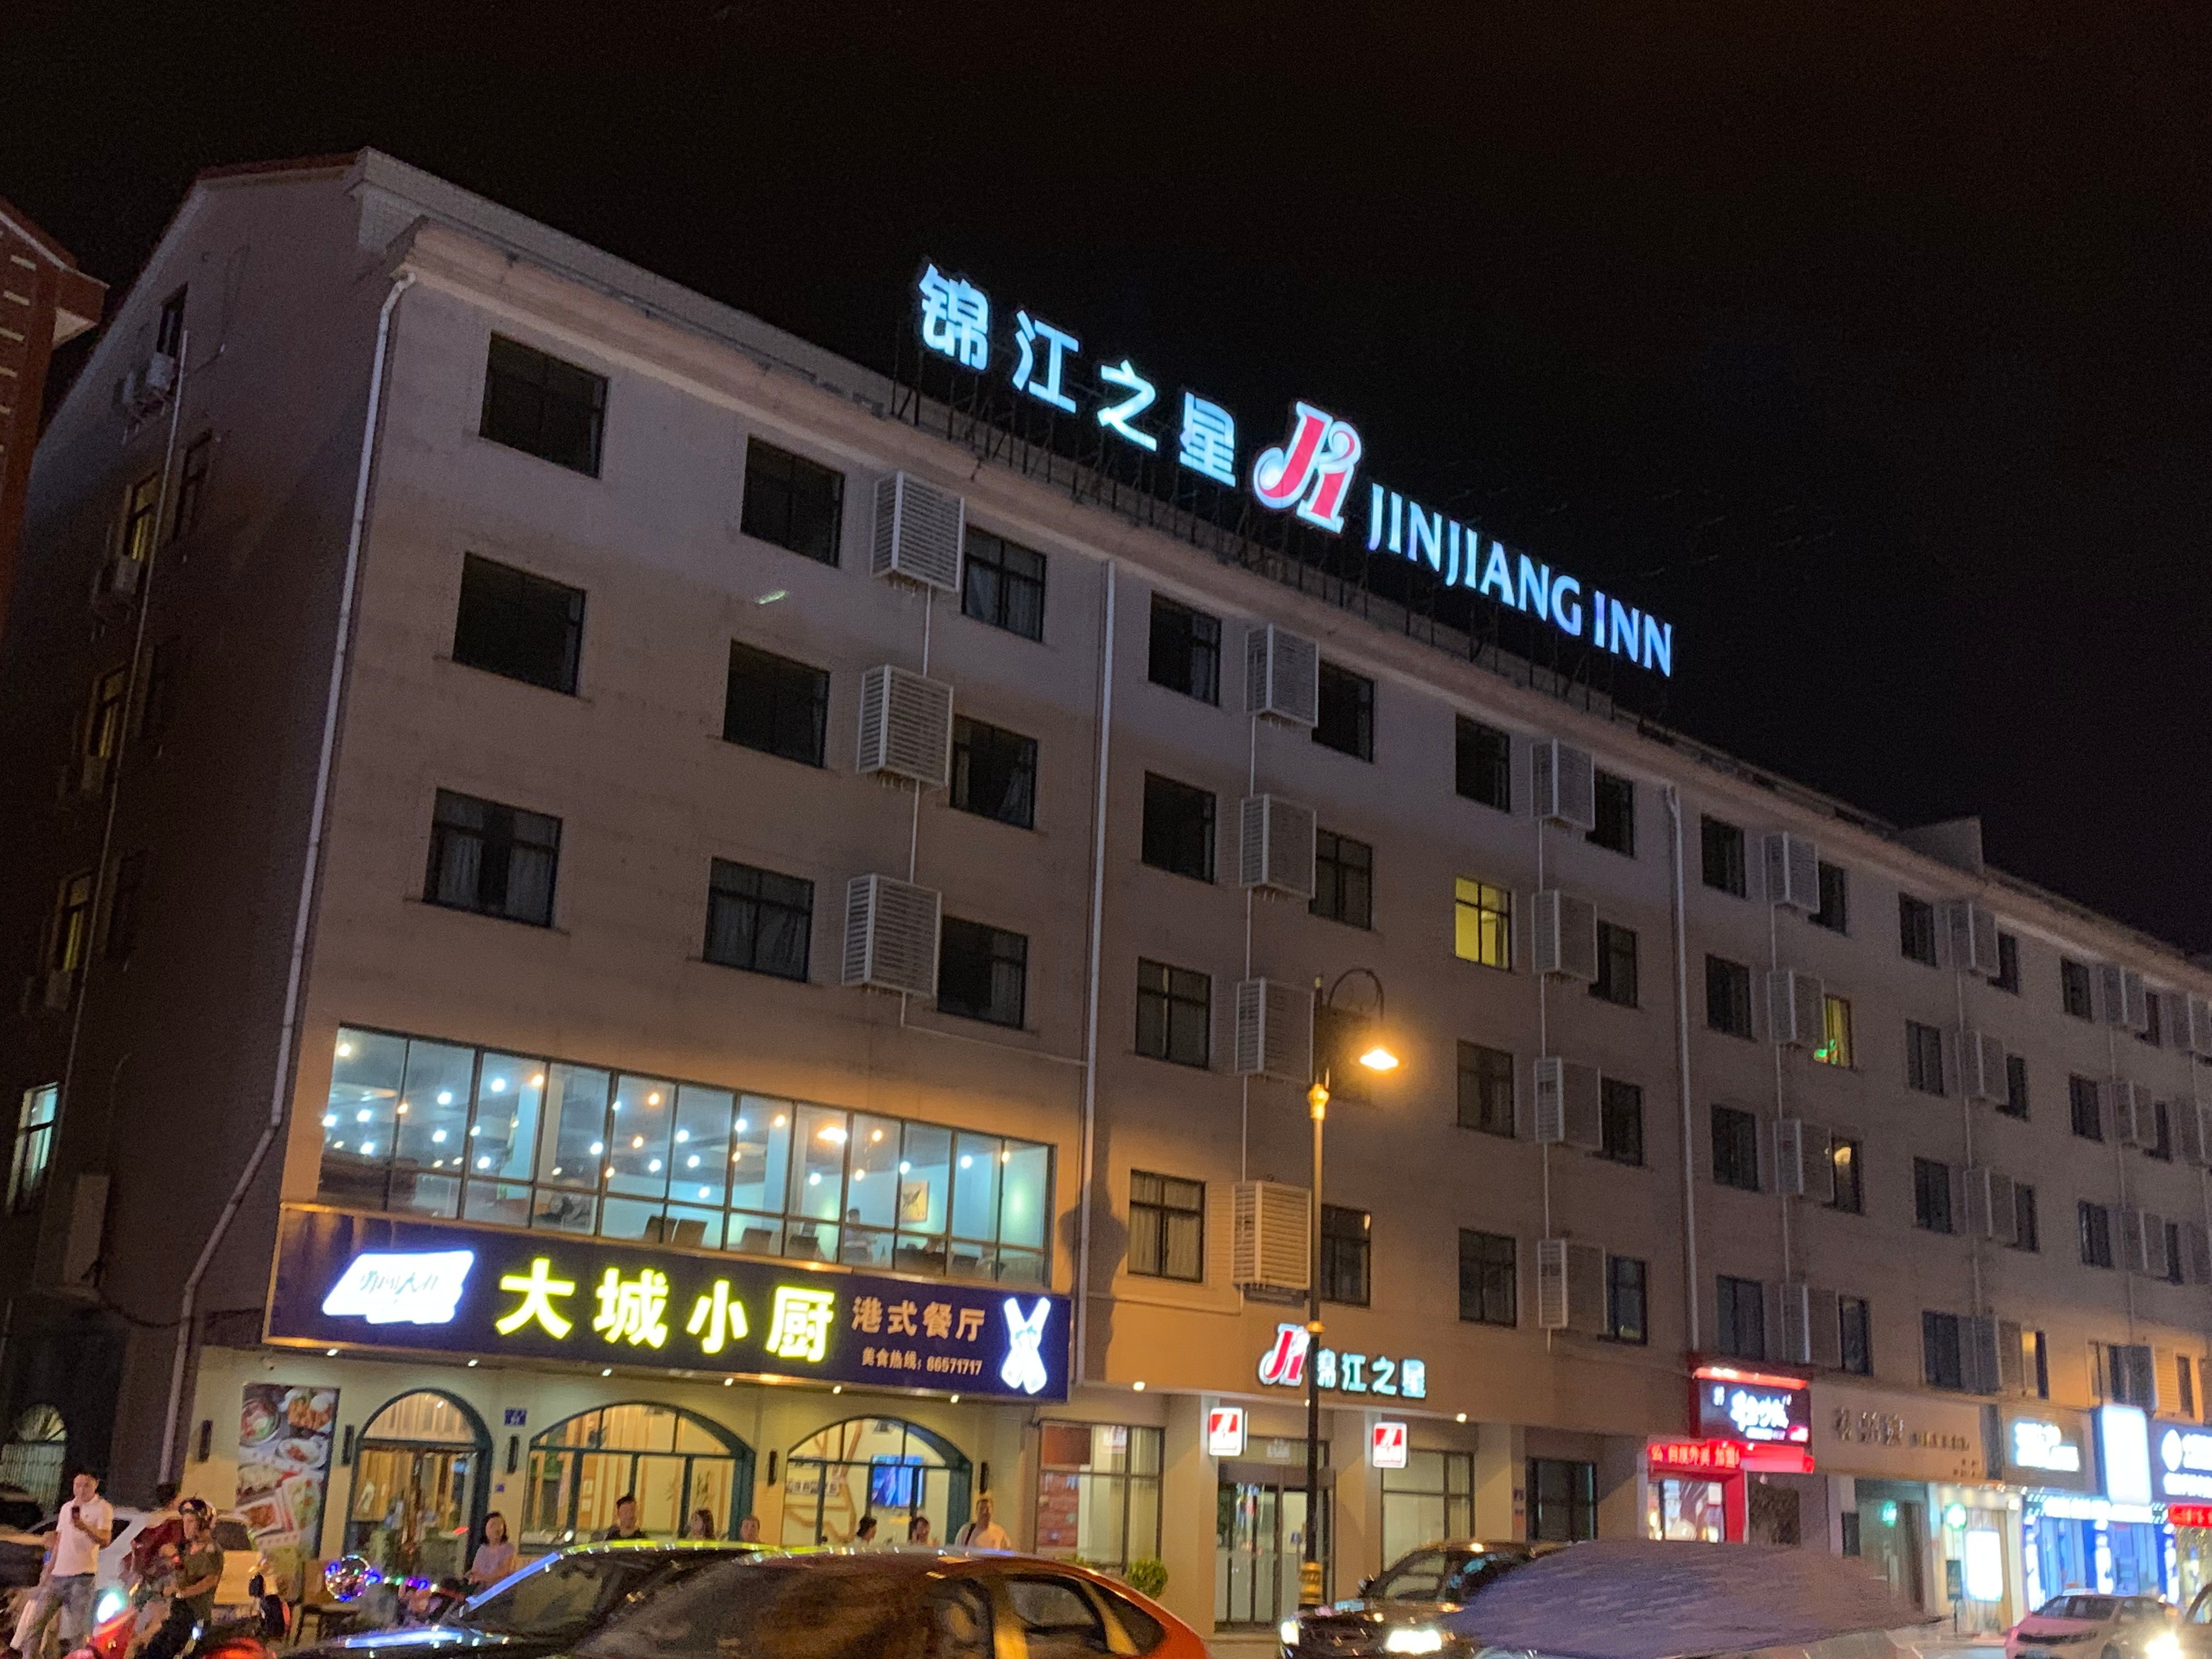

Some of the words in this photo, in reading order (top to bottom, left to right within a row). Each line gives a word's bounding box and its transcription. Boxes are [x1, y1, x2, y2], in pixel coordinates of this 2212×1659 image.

[918, 263, 1236, 488] 锦江之星
[1368, 482, 1582, 637] JINJIANG
[1594, 590, 1672, 678] INN
[494, 1257, 836, 1364] 大城小厨
[851, 1296, 986, 1342] 港式餐厅
